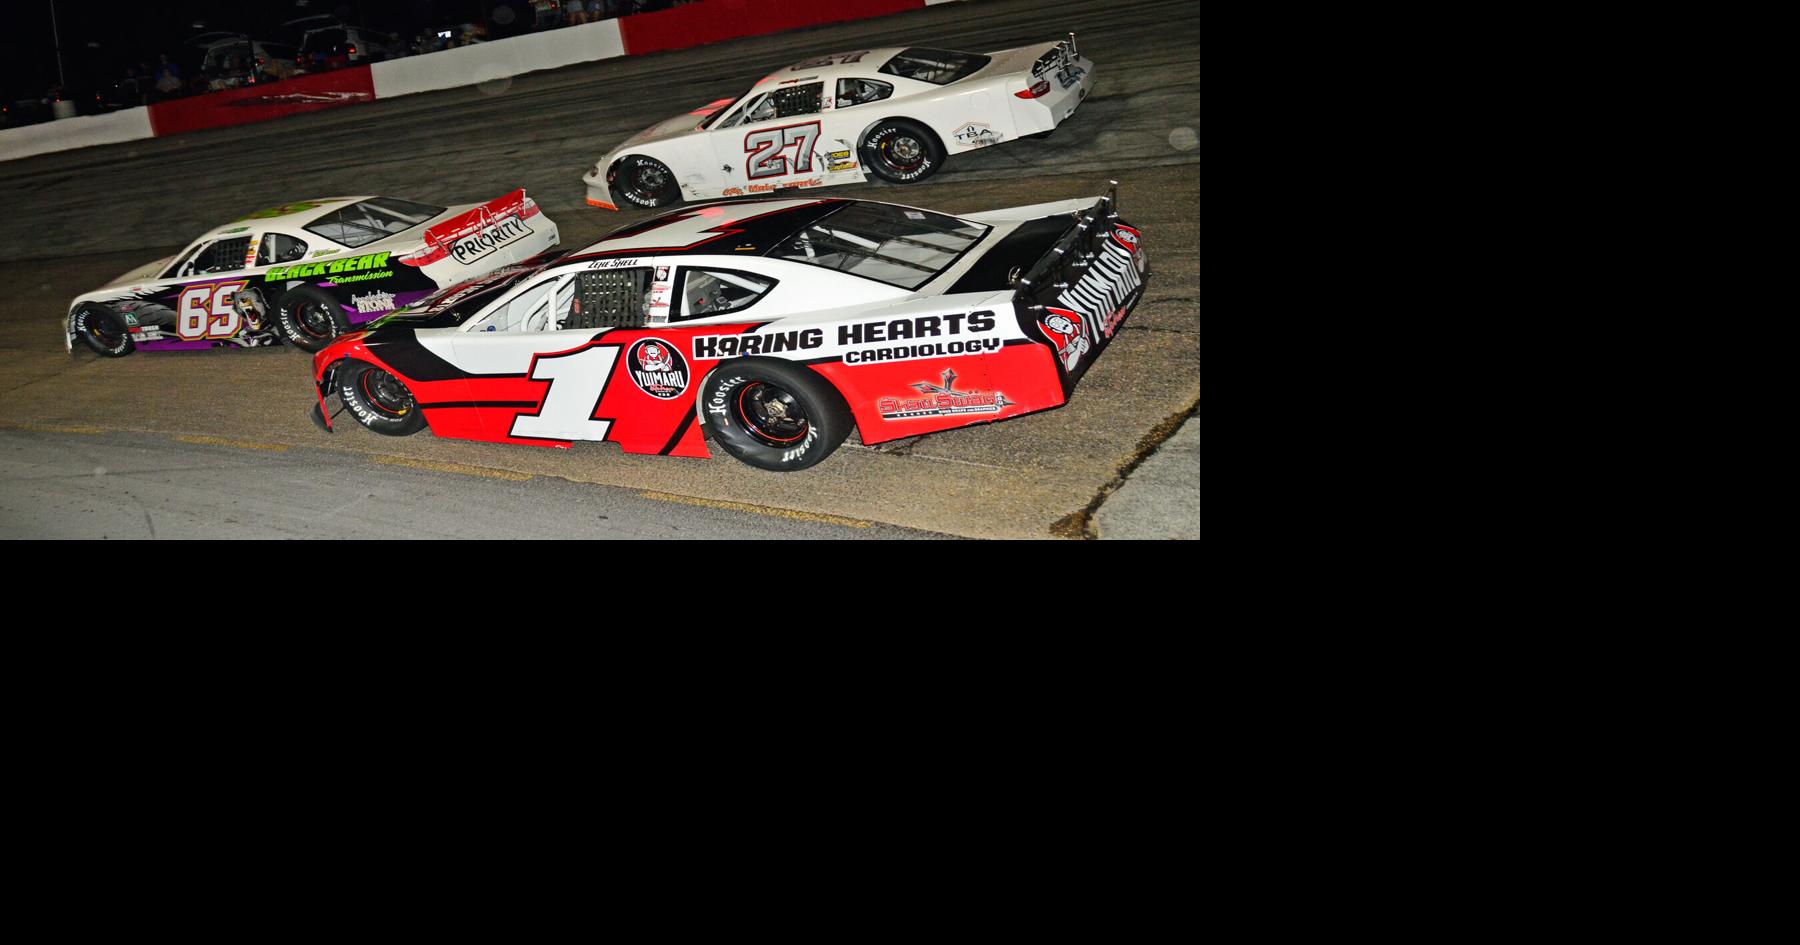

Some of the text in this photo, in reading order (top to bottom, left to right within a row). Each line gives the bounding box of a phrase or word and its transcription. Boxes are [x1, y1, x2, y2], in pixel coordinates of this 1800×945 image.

[744, 120, 822, 181] 27
[953, 128, 993, 141] TBA
[624, 191, 657, 208] Hoosier
[455, 218, 524, 261] PRIORITY
[265, 260, 331, 283] BLACK
[328, 251, 392, 274] BEAR
[325, 269, 394, 285] Transmission
[1057, 238, 1142, 345] YUIMARU
[694, 310, 997, 358] KARING HEARTS
[845, 337, 1001, 364] CARDIOLOGY
[508, 342, 626, 442] 1
[635, 370, 686, 388] YUIMARU
[708, 374, 746, 417] Hoosier
[342, 385, 379, 427] Hoosier
[781, 425, 818, 464] Hoosier
